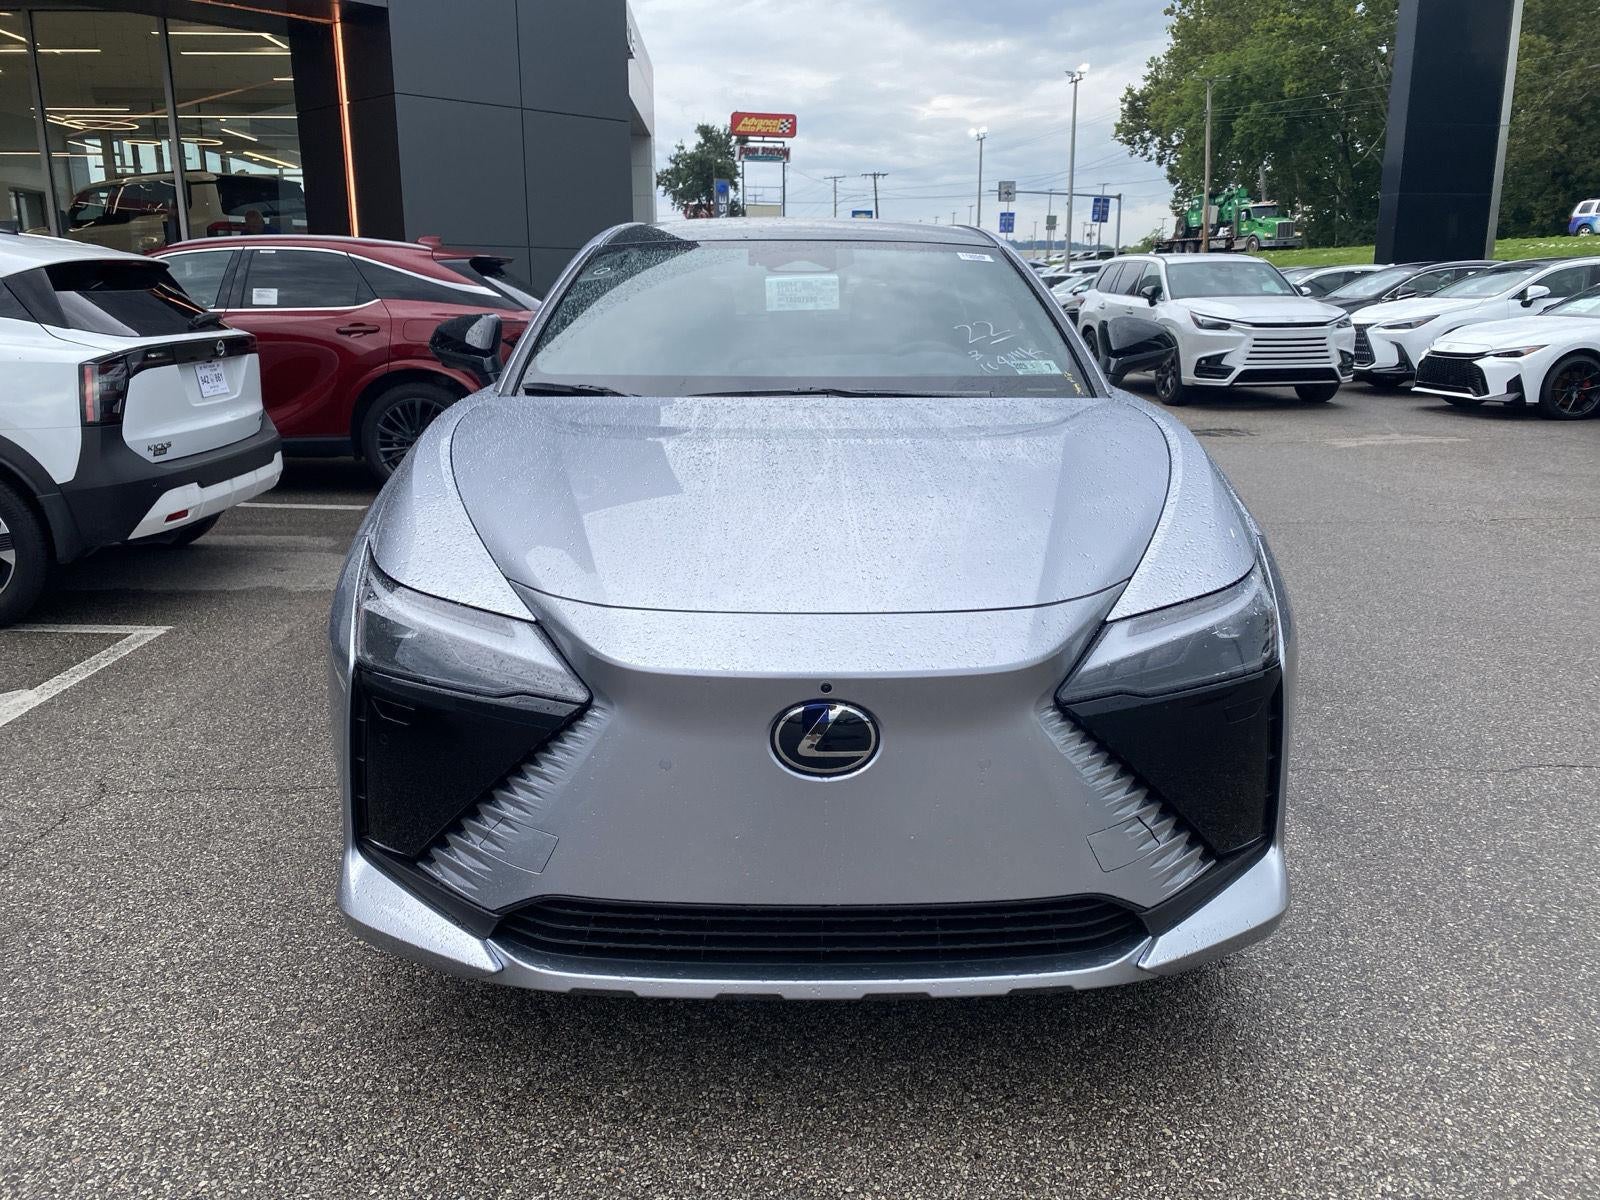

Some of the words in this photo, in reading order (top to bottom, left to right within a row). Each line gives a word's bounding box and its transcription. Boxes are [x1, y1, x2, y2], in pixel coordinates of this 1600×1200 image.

[741, 117, 778, 126] Advance
[739, 147, 759, 161] PENN
[761, 146, 790, 161] STATION
[147, 441, 172, 452] KICKS
